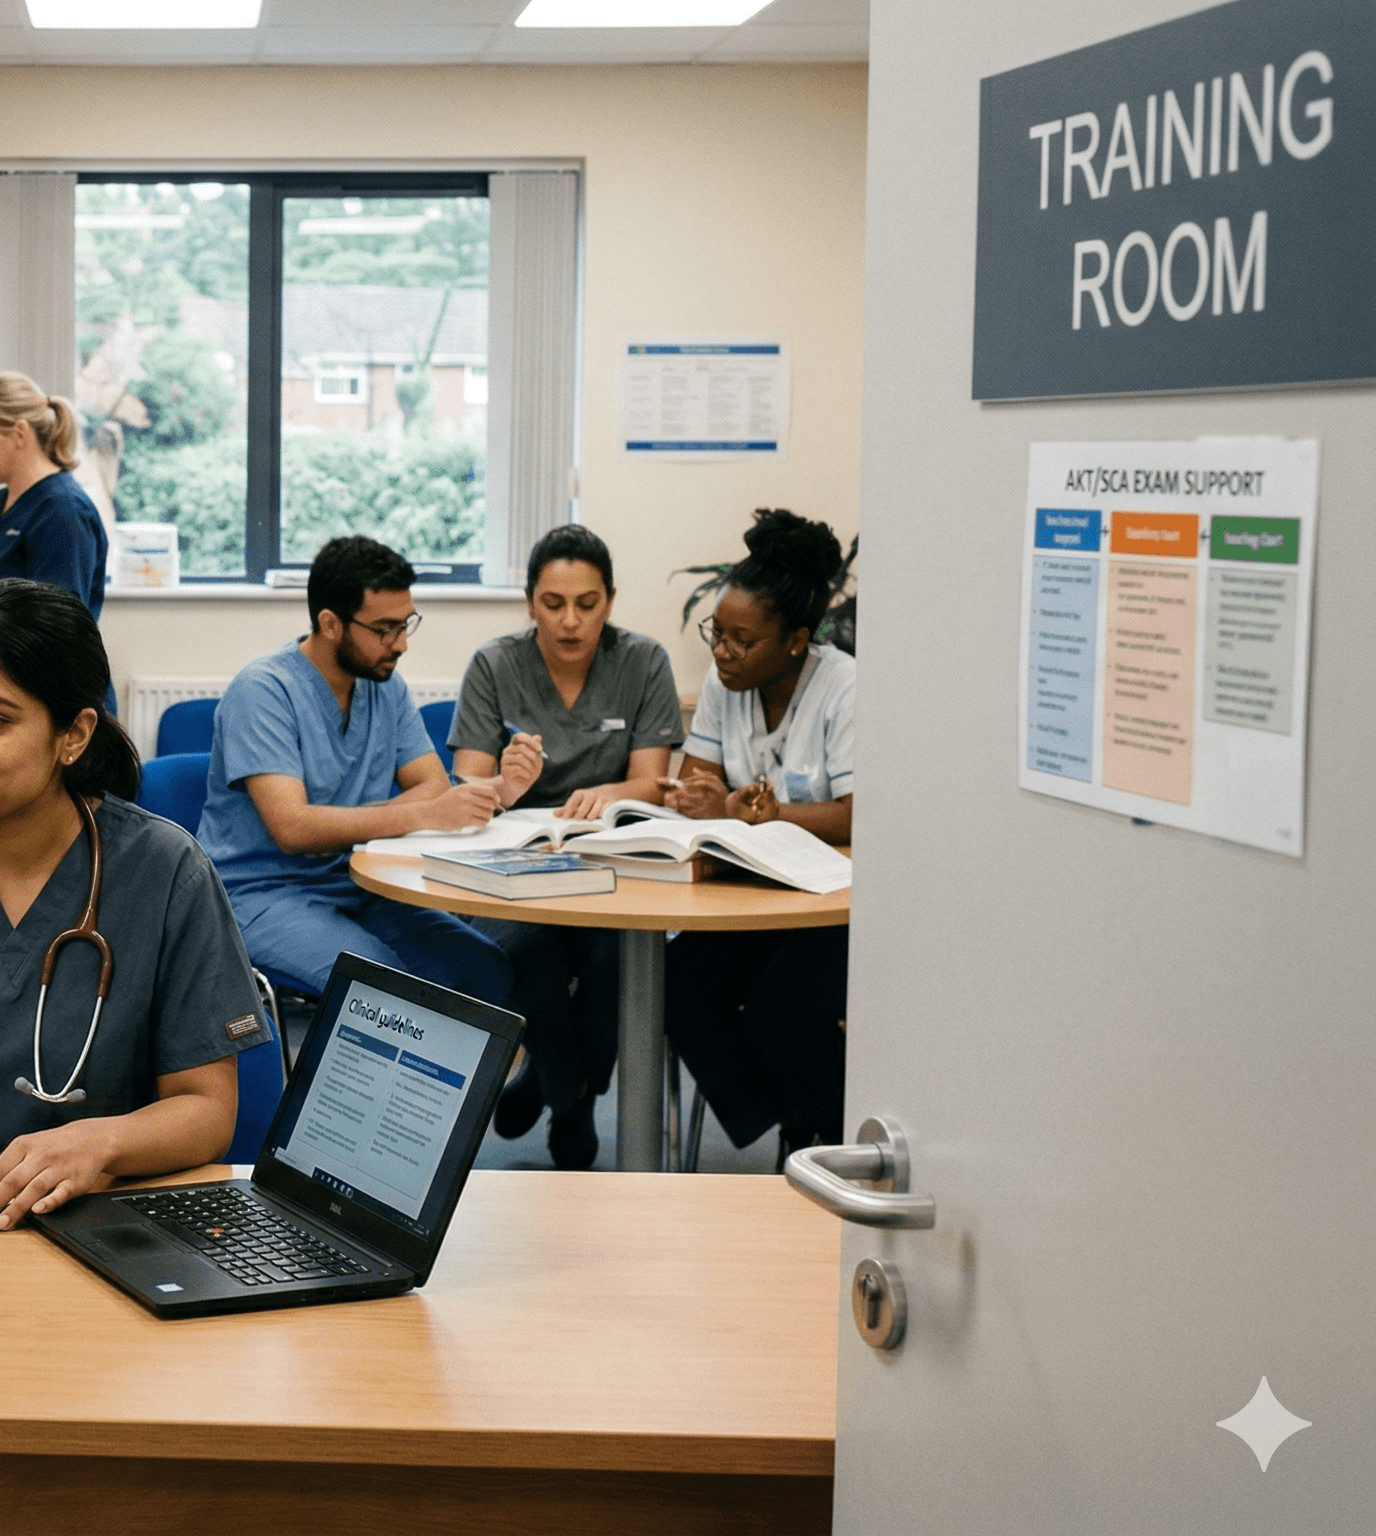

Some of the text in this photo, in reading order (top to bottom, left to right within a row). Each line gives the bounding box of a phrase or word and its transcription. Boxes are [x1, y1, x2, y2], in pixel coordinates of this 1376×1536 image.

[1029, 50, 1334, 209] TRAINING
[1072, 210, 1268, 330] ROOM
[1065, 467, 1266, 497] AKT/SCA EXAM SUPPORT
